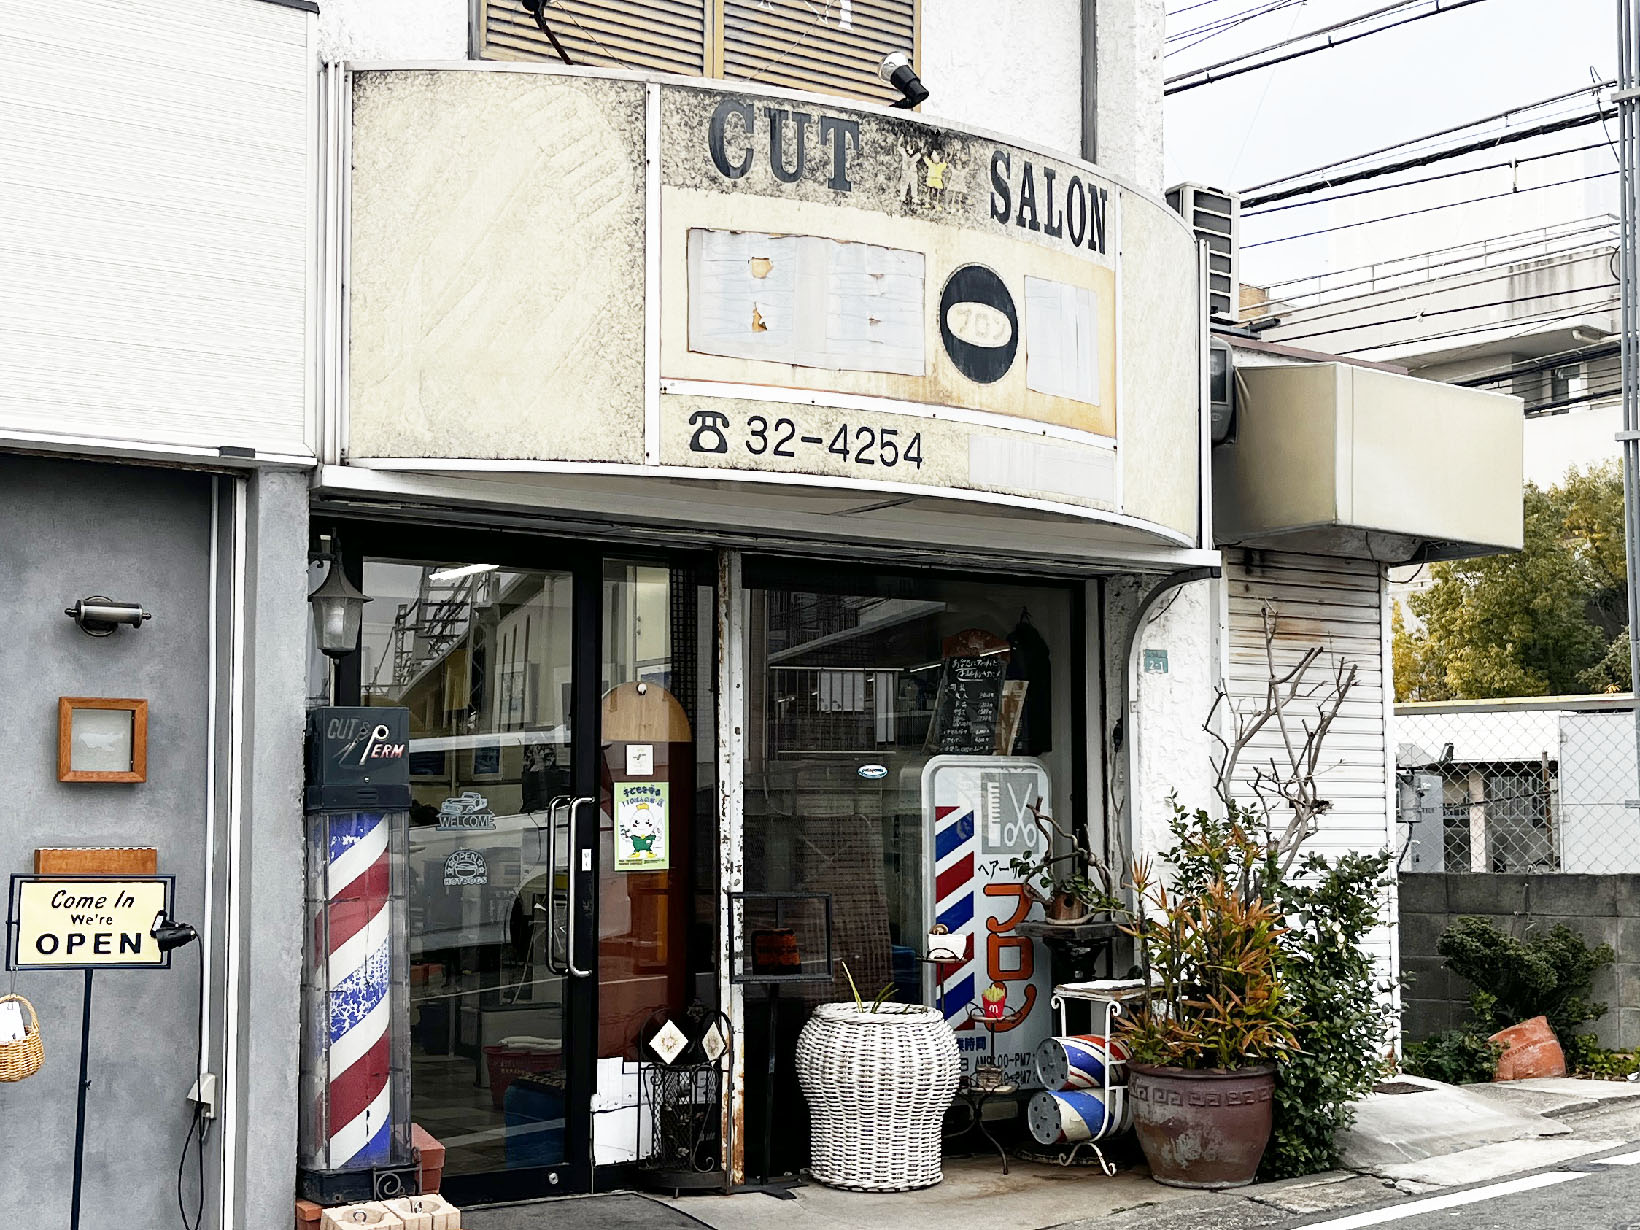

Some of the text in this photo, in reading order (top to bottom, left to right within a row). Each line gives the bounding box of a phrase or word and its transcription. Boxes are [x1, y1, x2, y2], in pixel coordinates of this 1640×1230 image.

[707, 101, 1108, 256] CUT SALON
[745, 415, 923, 469] 32-4254
[327, 716, 360, 741] CUT
[439, 814, 495, 828] WELCOME
[452, 852, 478, 863] OPEN
[51, 889, 135, 909] Come In
[70, 914, 113, 925] We're
[35, 932, 142, 955] OPEN
